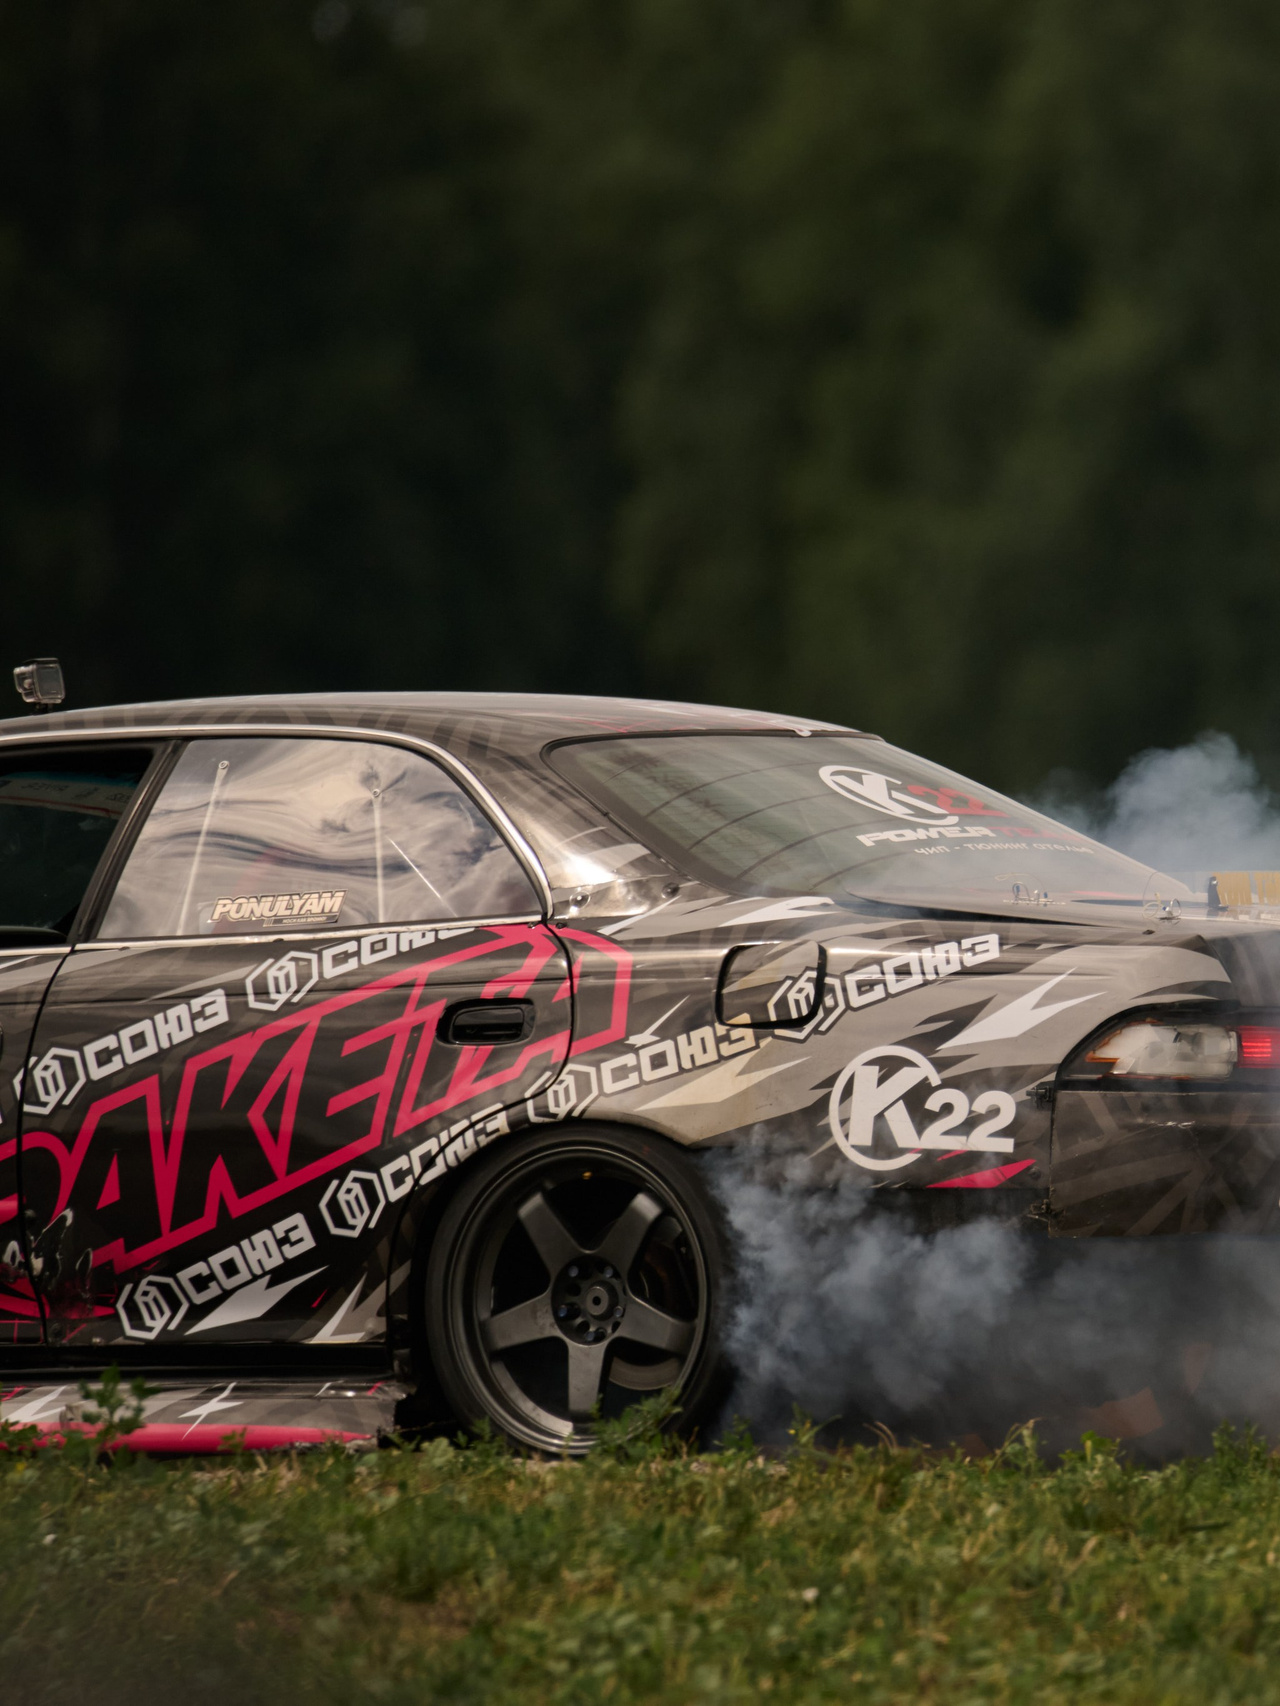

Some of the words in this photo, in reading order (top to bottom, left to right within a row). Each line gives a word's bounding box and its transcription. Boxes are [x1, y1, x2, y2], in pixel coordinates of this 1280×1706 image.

[211, 890, 345, 920] PONULYAM
[322, 928, 475, 980] СОЮ
[845, 933, 1000, 1008] СОЮЗ
[83, 988, 229, 1081] СОЮЗ
[600, 1012, 756, 1094] СОЮЗ
[829, 1045, 1016, 1171] K22
[380, 1102, 510, 1203] СОЮЗ
[176, 1212, 317, 1305] СОЮЗ
